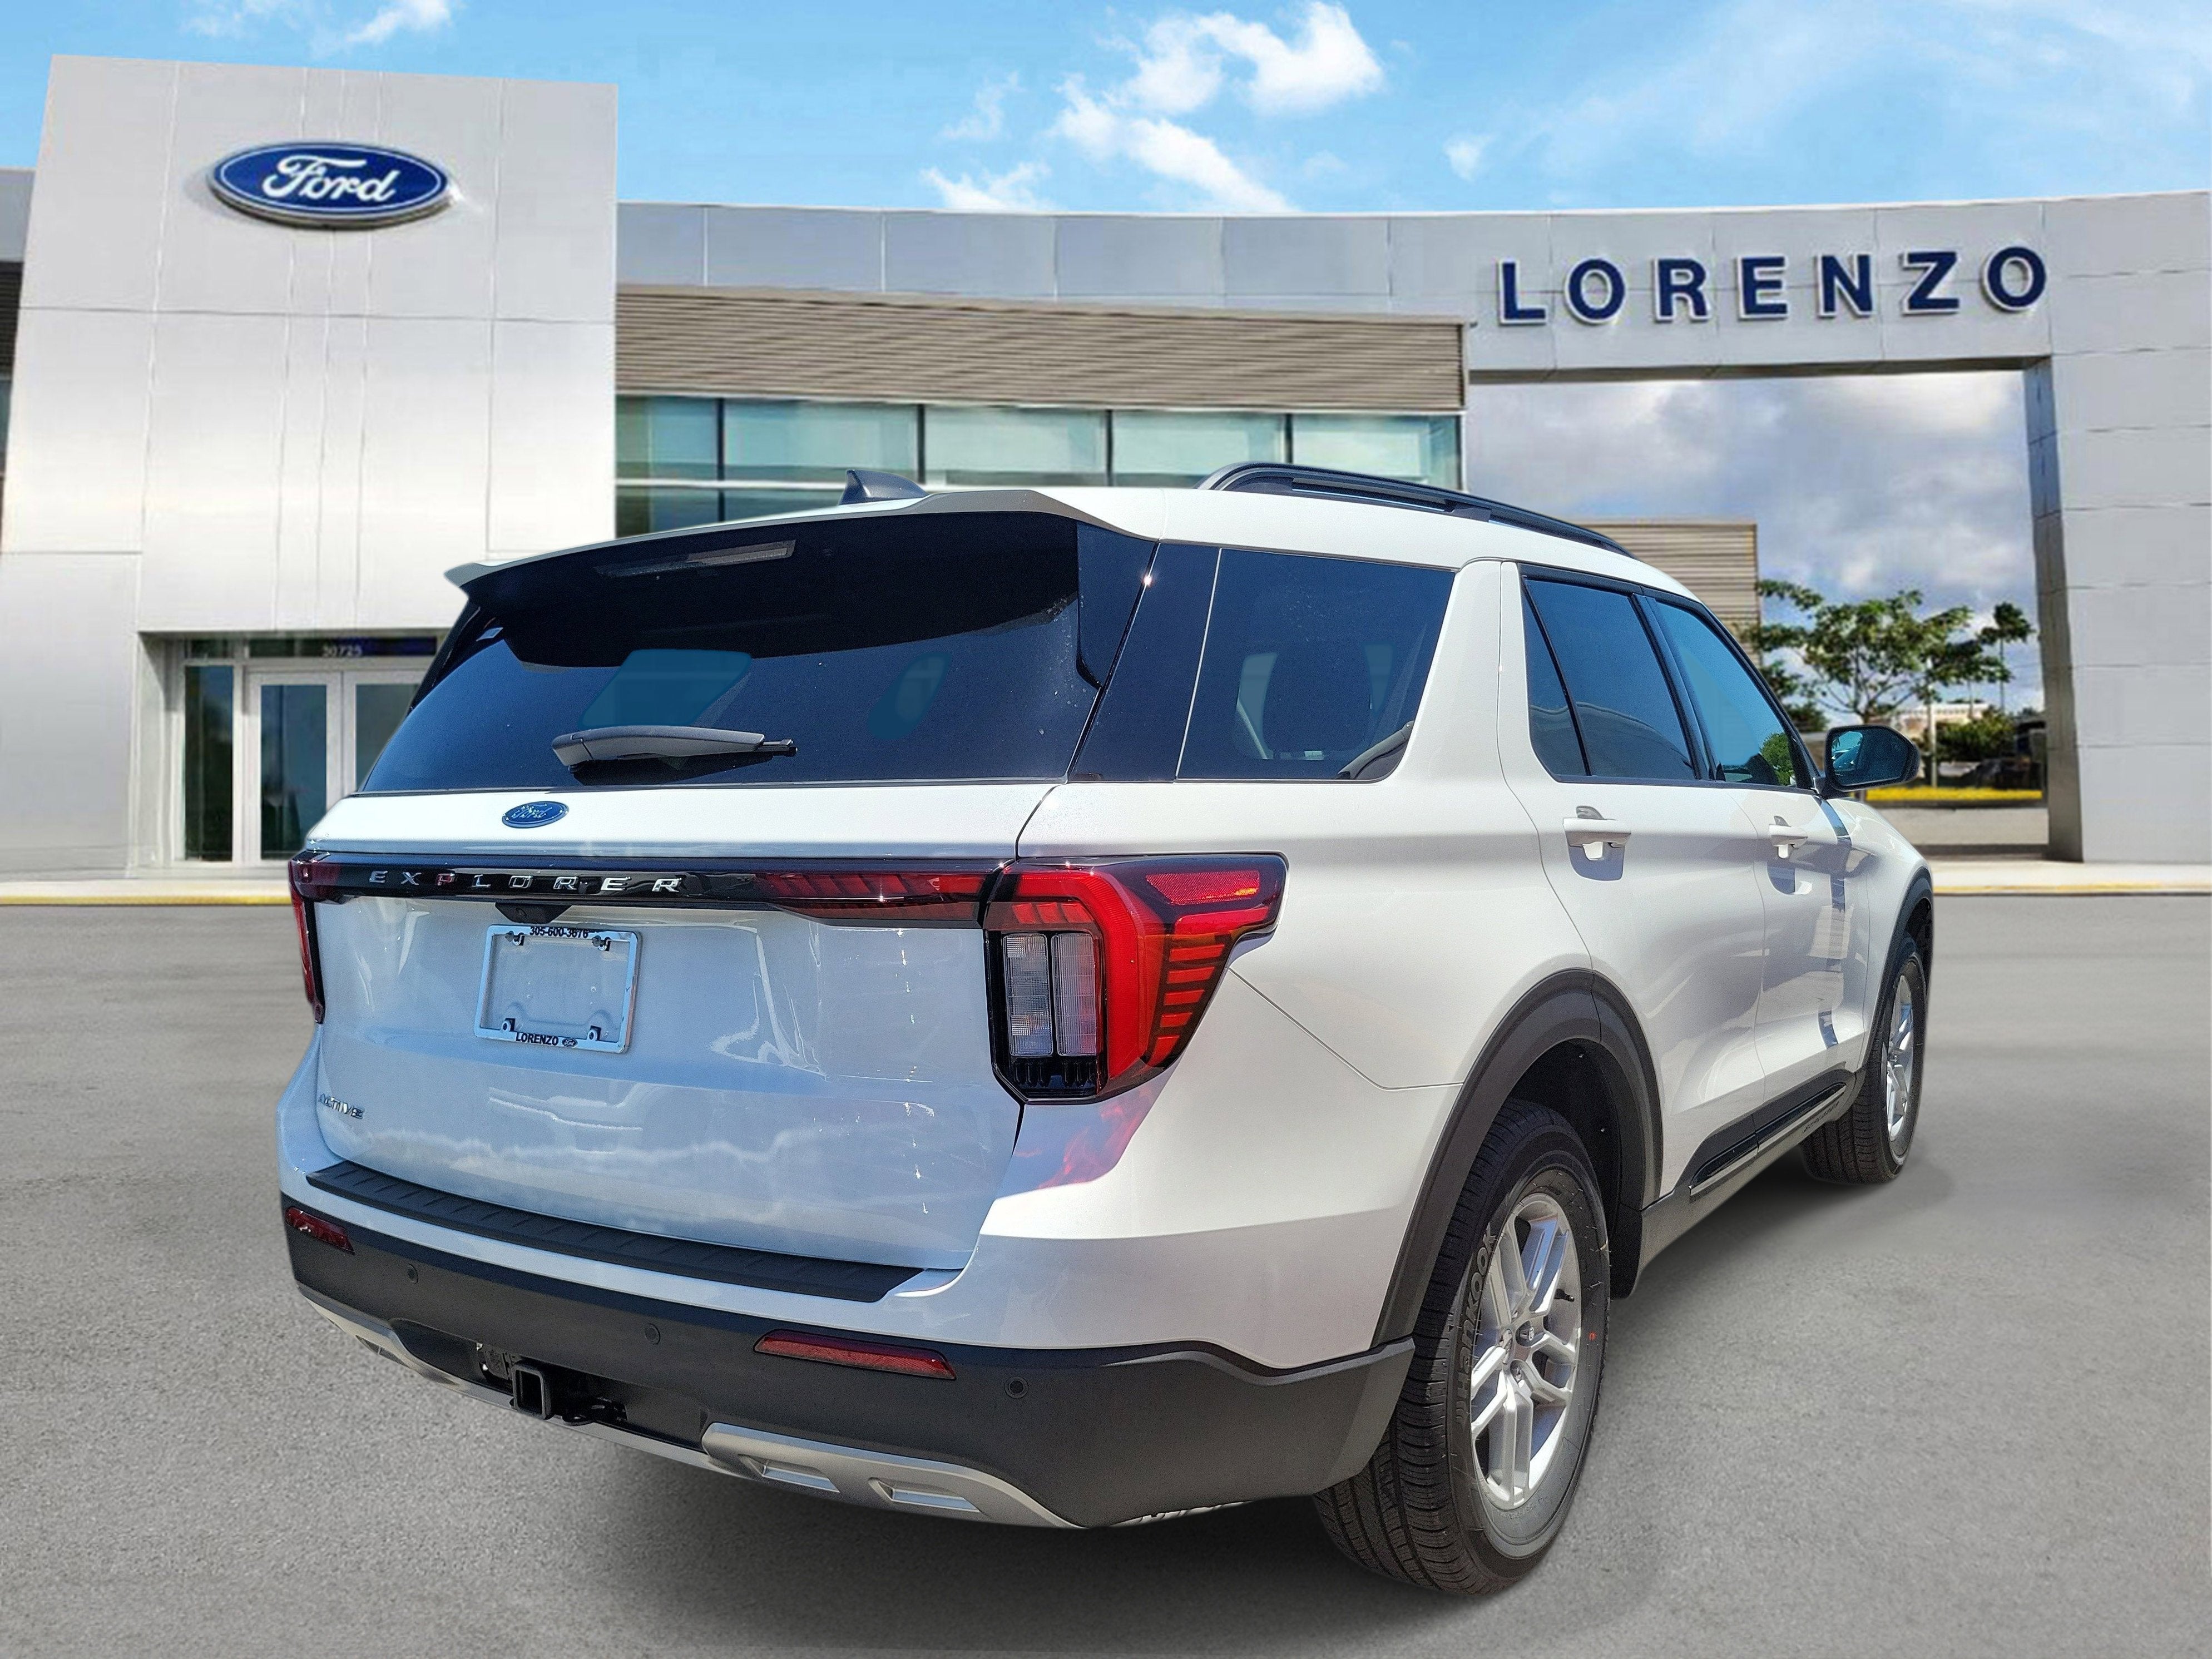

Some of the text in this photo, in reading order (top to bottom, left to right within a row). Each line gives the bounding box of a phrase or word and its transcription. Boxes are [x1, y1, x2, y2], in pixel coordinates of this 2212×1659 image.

[262, 155, 401, 202] Ford
[1497, 246, 2046, 325] LORENZO
[511, 803, 553, 819] Ford
[369, 870, 683, 893] EXPLORER
[516, 1032, 559, 1046] LORENZO
